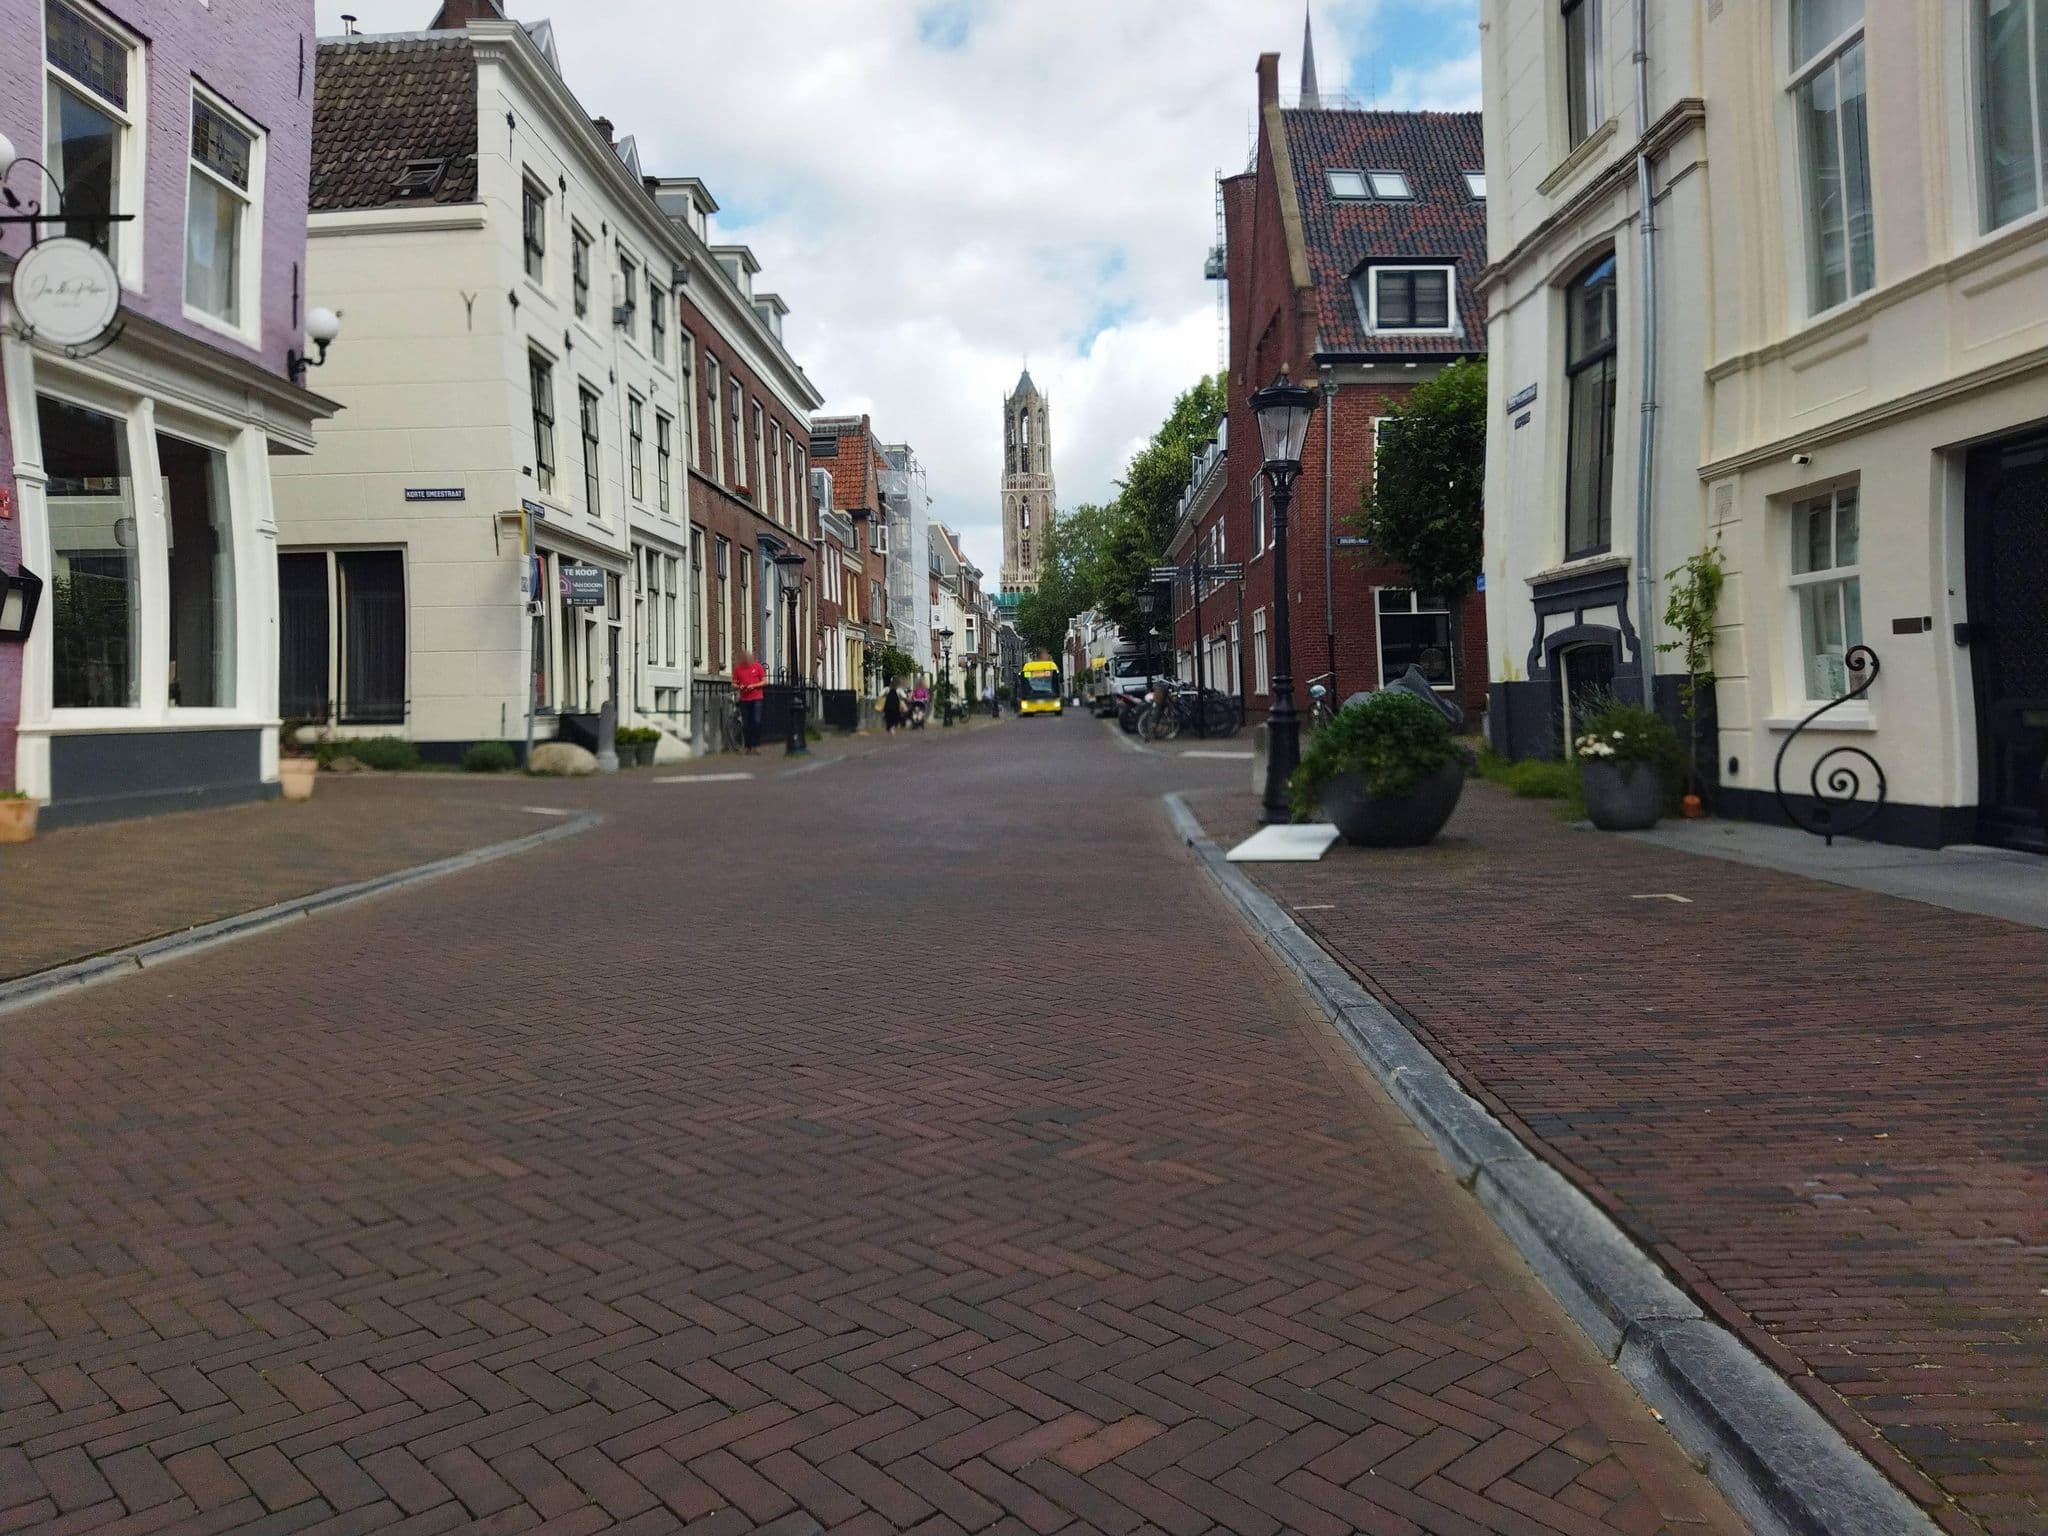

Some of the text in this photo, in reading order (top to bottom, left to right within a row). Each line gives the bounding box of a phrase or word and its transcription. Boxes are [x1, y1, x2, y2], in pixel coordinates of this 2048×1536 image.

[406, 490, 462, 498] KORTE SMEESTRAAT
[564, 568, 599, 576] TE KOOP
